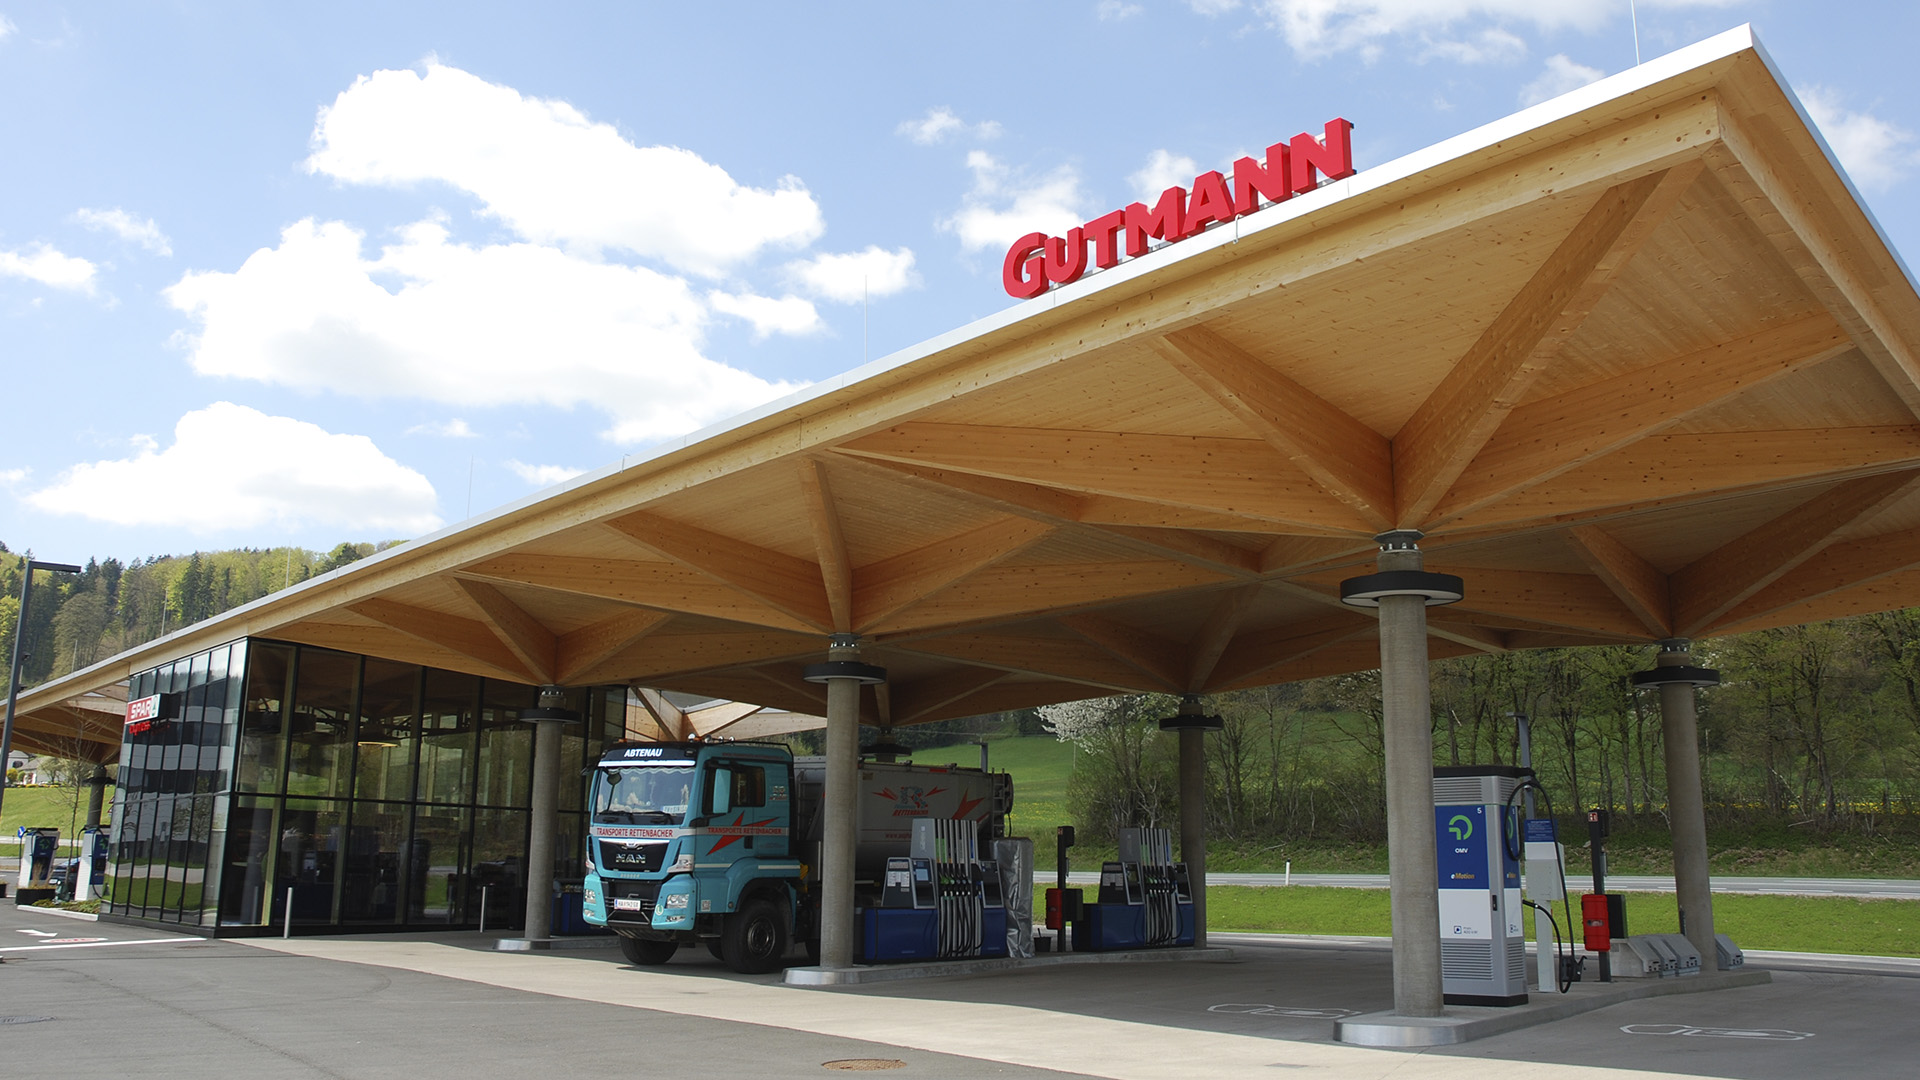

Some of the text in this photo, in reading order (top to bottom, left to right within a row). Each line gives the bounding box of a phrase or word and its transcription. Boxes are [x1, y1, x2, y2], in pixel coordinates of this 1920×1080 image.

[1002, 117, 1354, 299] GUTMANN
[130, 700, 152, 720] SPAR
[623, 748, 663, 758] ABTENAU
[596, 827, 674, 838] TRANSPORTE RETTENBACHER
[616, 853, 646, 864] MAN
